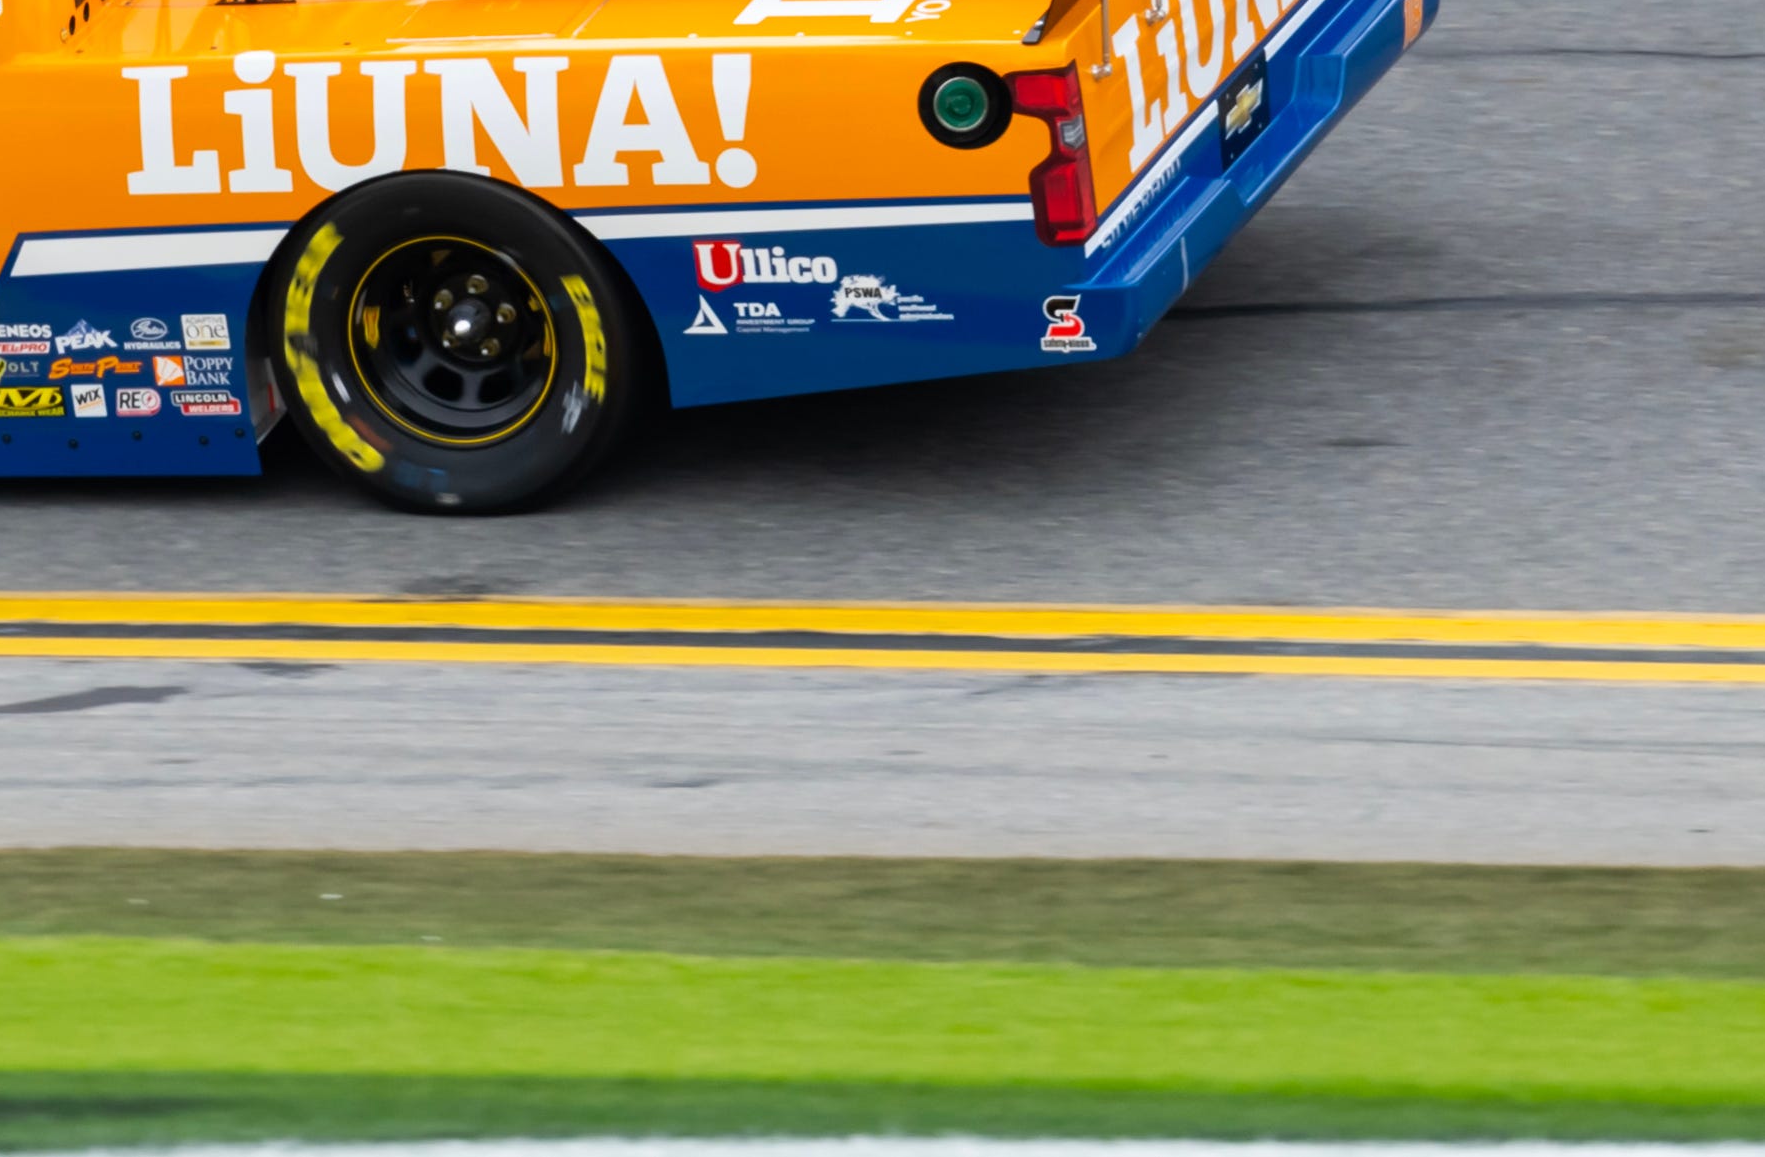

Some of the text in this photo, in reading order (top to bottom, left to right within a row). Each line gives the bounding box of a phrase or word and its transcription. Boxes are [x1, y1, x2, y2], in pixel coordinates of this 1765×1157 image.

[121, 49, 758, 196] LiUNA!
[694, 243, 838, 285] Ullico
[844, 287, 883, 299] PSWA
[733, 301, 782, 318] TDA
[55, 329, 118, 355] PEAK
[123, 340, 182, 351] HYDRAULICS
[183, 355, 234, 371] POPPY
[186, 371, 231, 386] BANK
[75, 388, 102, 406] WIX
[174, 393, 228, 404] LINCOLN
[189, 404, 236, 413] WELDERS
